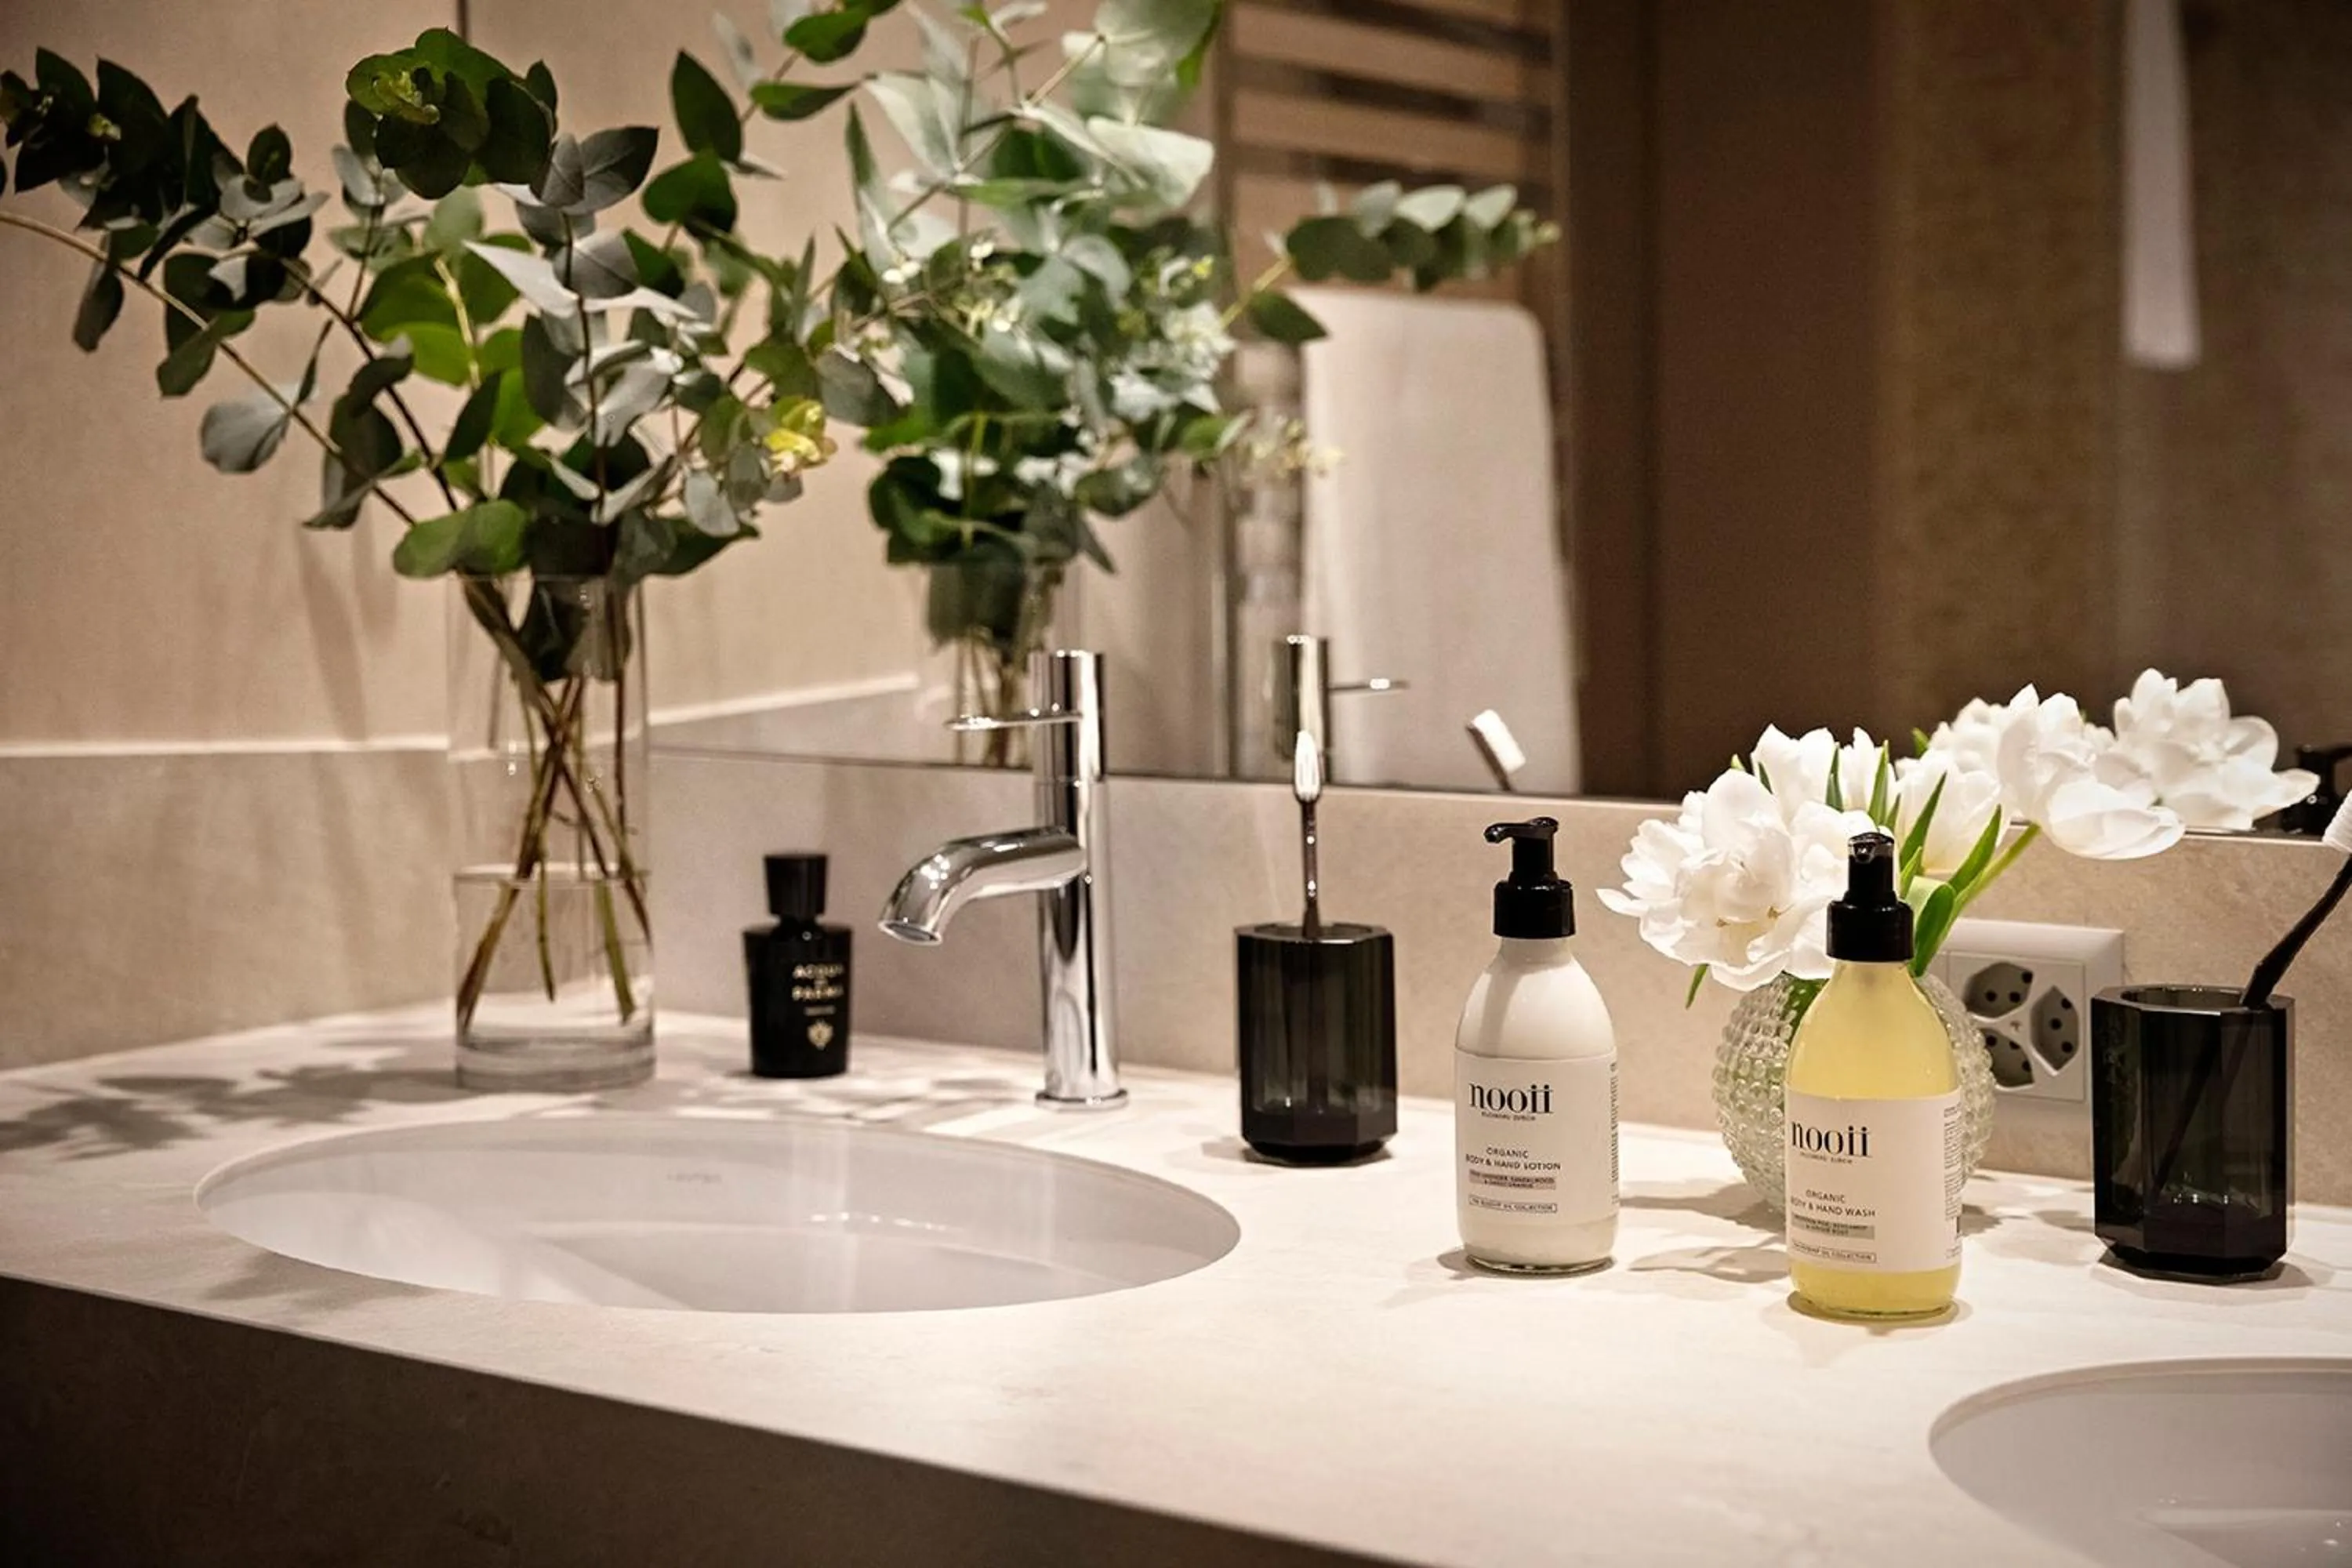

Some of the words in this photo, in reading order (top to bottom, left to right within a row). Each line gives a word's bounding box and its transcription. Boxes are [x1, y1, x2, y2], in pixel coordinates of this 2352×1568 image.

[1468, 1083, 1554, 1113] nooii
[1791, 1120, 1872, 1158] nooii
[1486, 1147, 1529, 1158] ORGANIC
[1465, 1153, 1484, 1164] BODY
[1494, 1160, 1520, 1169] HAND
[1524, 1162, 1561, 1171] LOTION
[1806, 1189, 1846, 1203] ORGANIC
[1817, 1203, 1842, 1215] HAND
[1846, 1207, 1876, 1218] WASH
